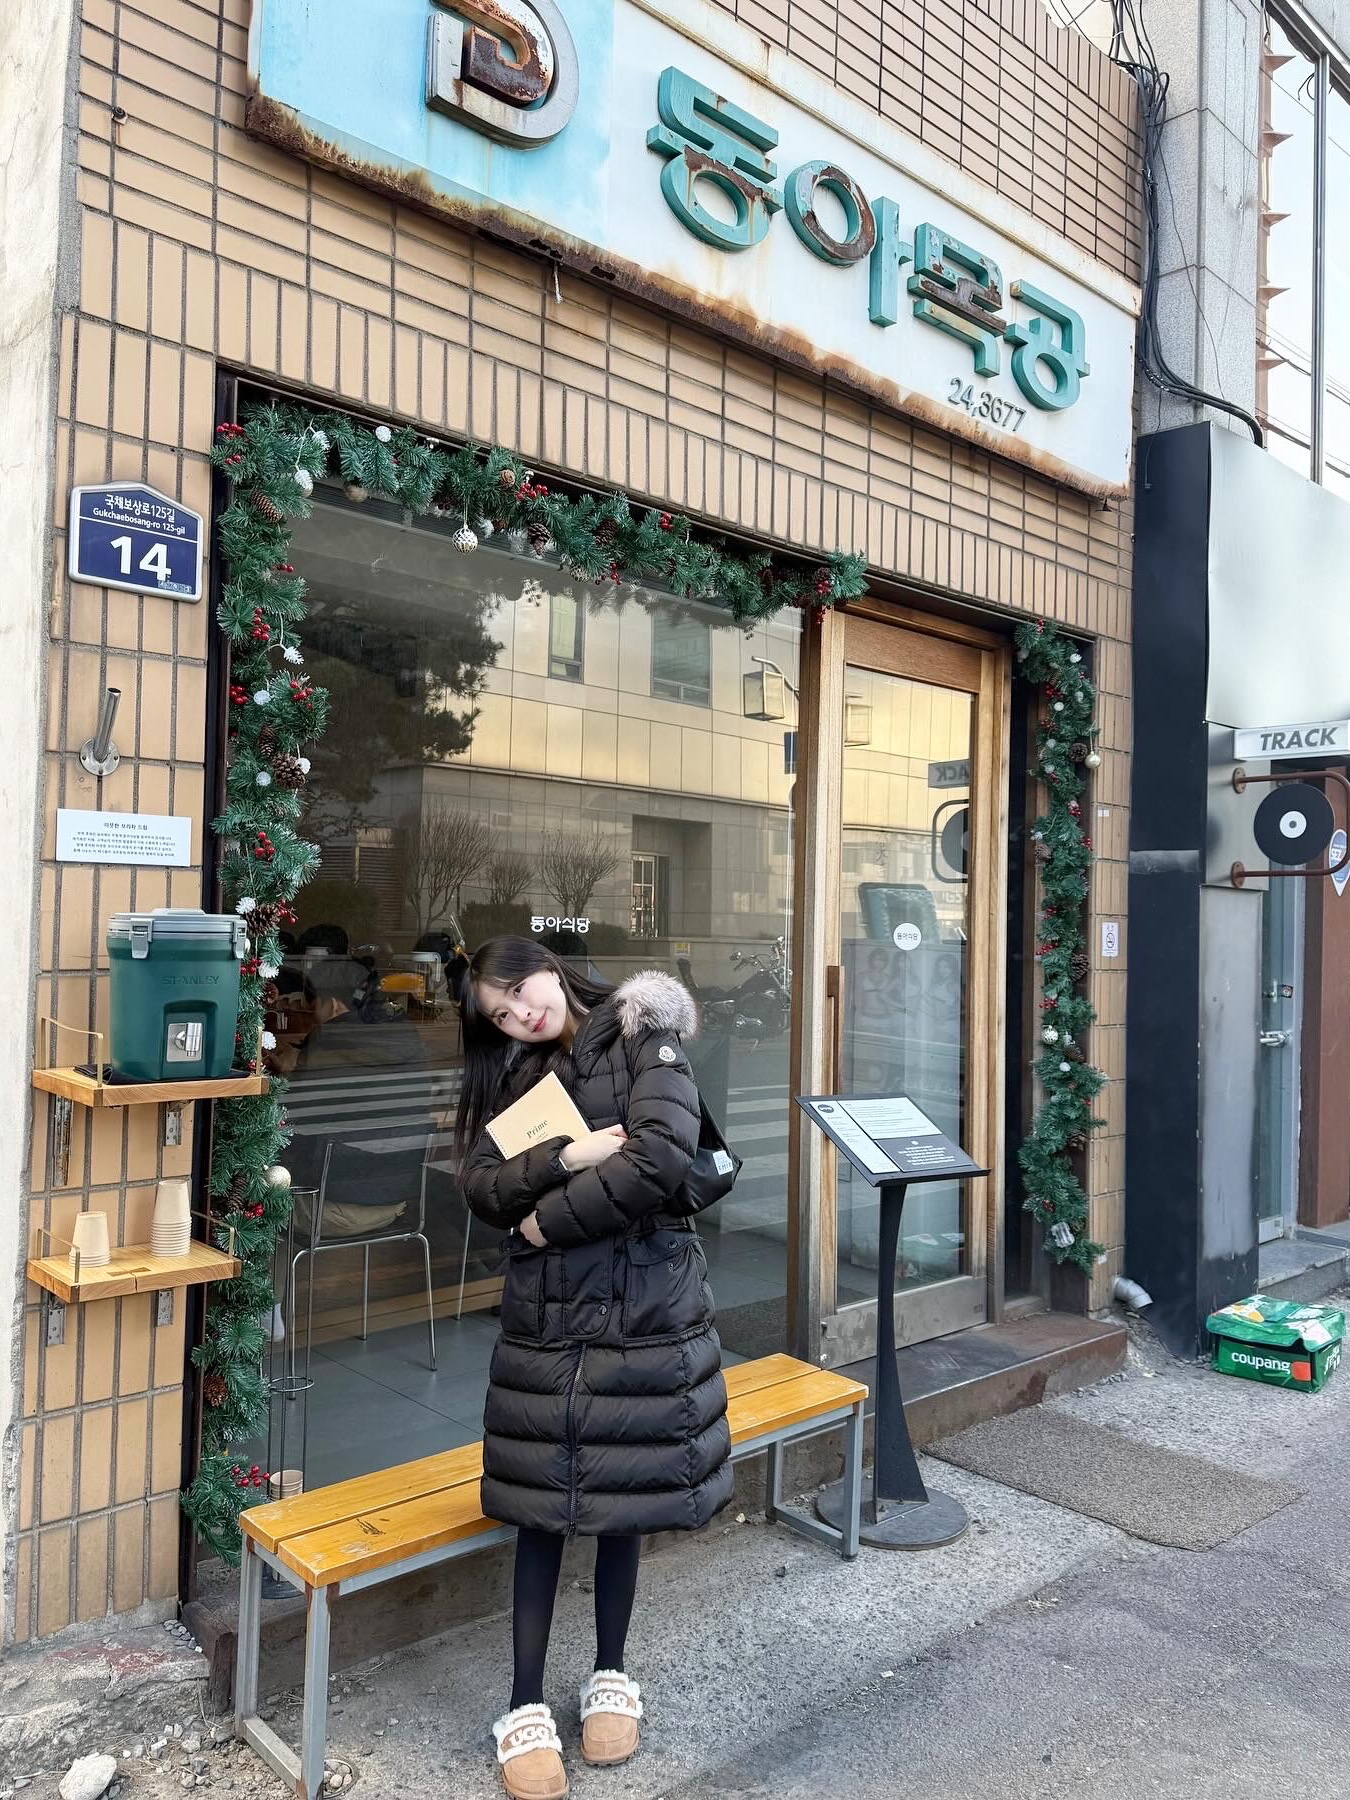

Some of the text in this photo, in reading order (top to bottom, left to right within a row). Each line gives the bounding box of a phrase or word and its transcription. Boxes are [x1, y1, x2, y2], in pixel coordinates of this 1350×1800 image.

[105, 494, 175, 524] 국채보상로125길
[93, 507, 186, 536] Gukchaebosang-ro 125-gil
[110, 535, 172, 583] 14
[1260, 727, 1338, 751] TRACK
[530, 915, 591, 934] 동아식당
[163, 976, 219, 985] STANLEY
[526, 1119, 548, 1139] Prime
[1231, 1352, 1292, 1374] coupang
